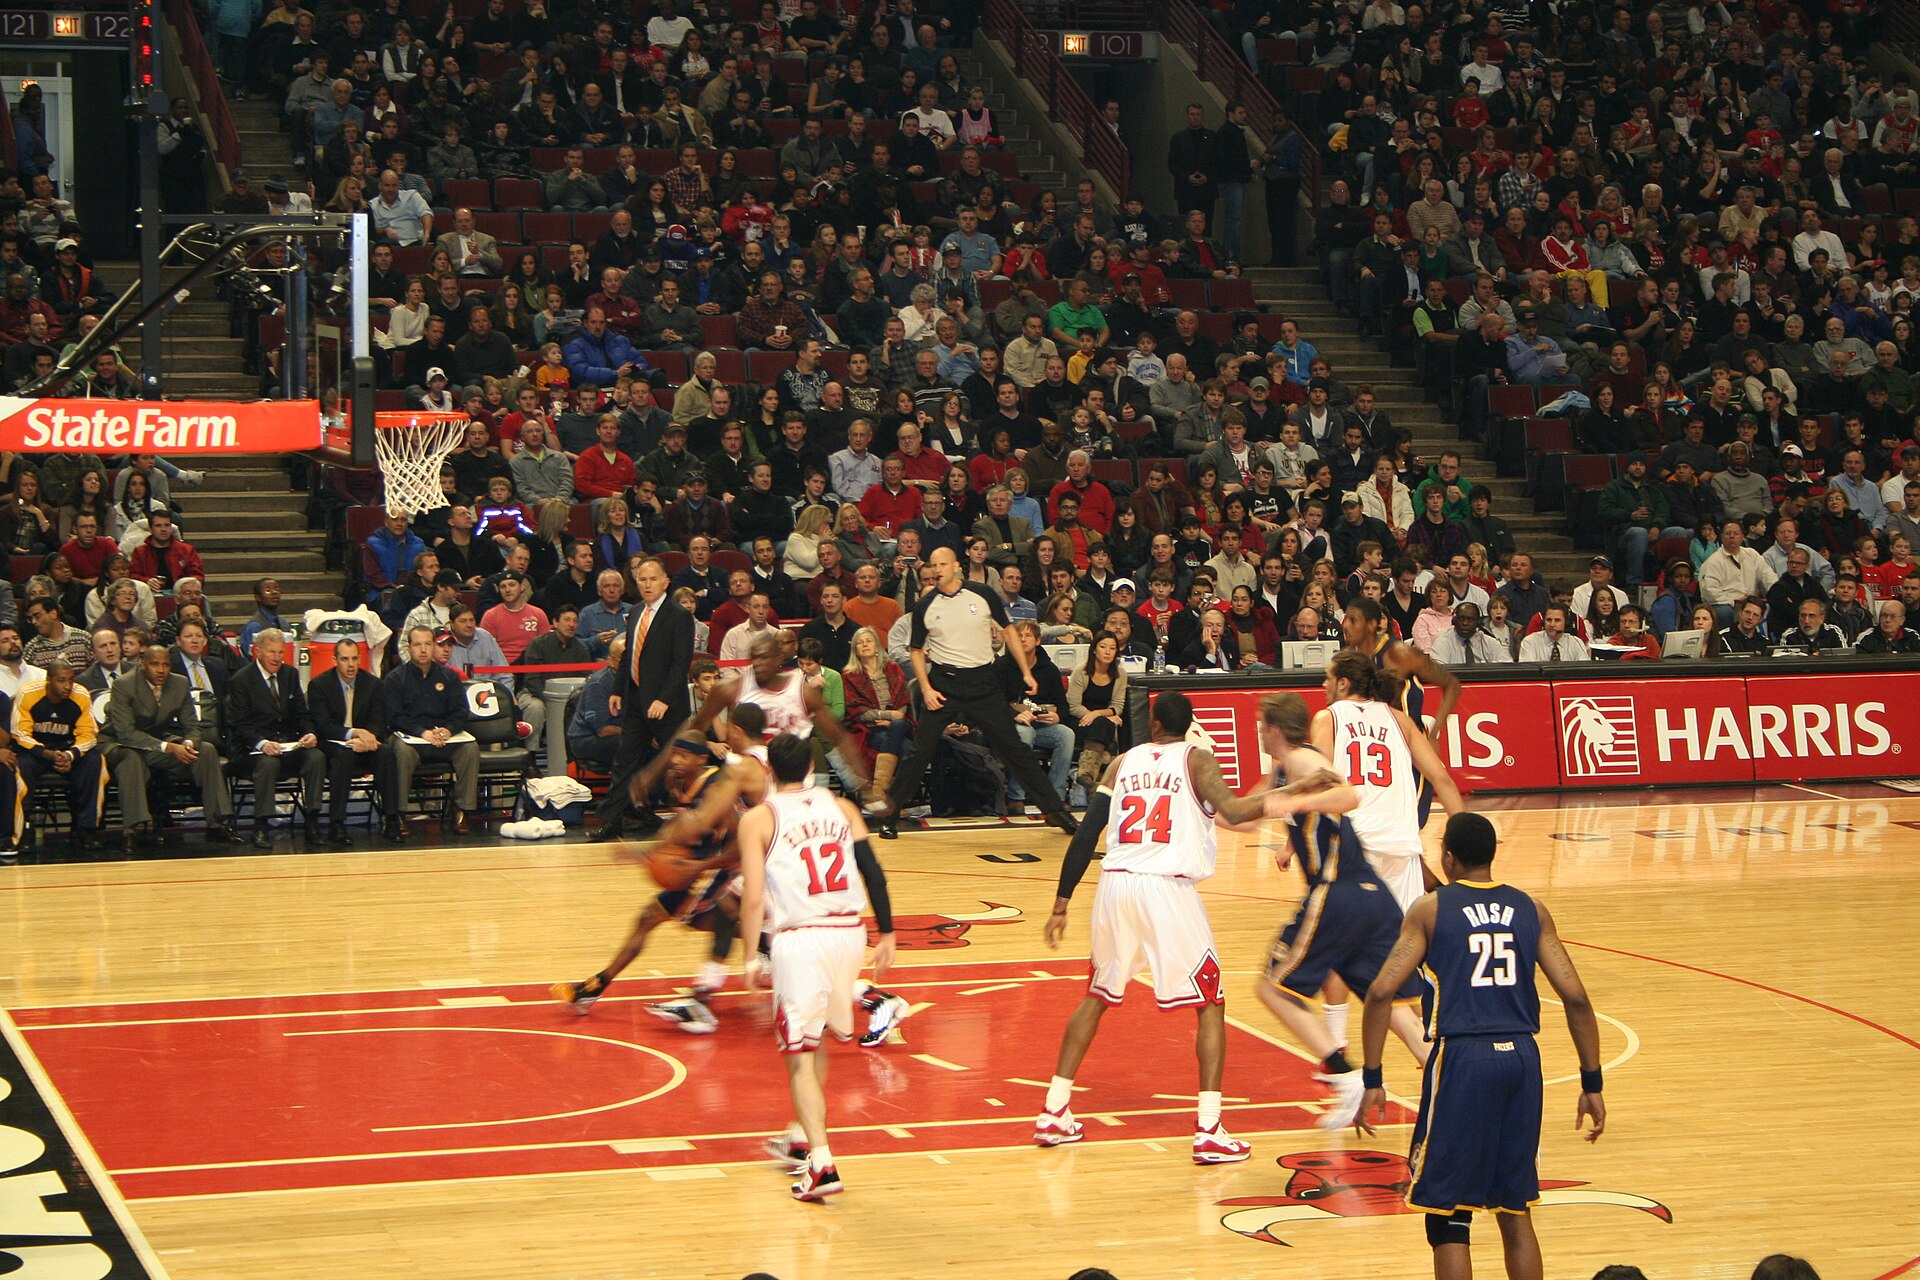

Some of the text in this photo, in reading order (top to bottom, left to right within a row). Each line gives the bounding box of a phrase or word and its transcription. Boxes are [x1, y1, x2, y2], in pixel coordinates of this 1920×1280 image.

[3, 14, 34, 35] 121
[55, 17, 80, 34] EXIT
[95, 16, 129, 37] 122
[1065, 37, 1087, 52] EXIT
[1101, 35, 1130, 55] 101
[524, 621, 538, 631] 22
[466, 682, 500, 717] G
[1345, 721, 1389, 743] NOAH
[1346, 741, 1393, 787] 13
[1120, 772, 1183, 794] THOMAS
[1119, 795, 1172, 844] 24
[800, 842, 849, 896] 12
[1462, 902, 1515, 928] RUSH
[1468, 933, 1517, 987] 25
